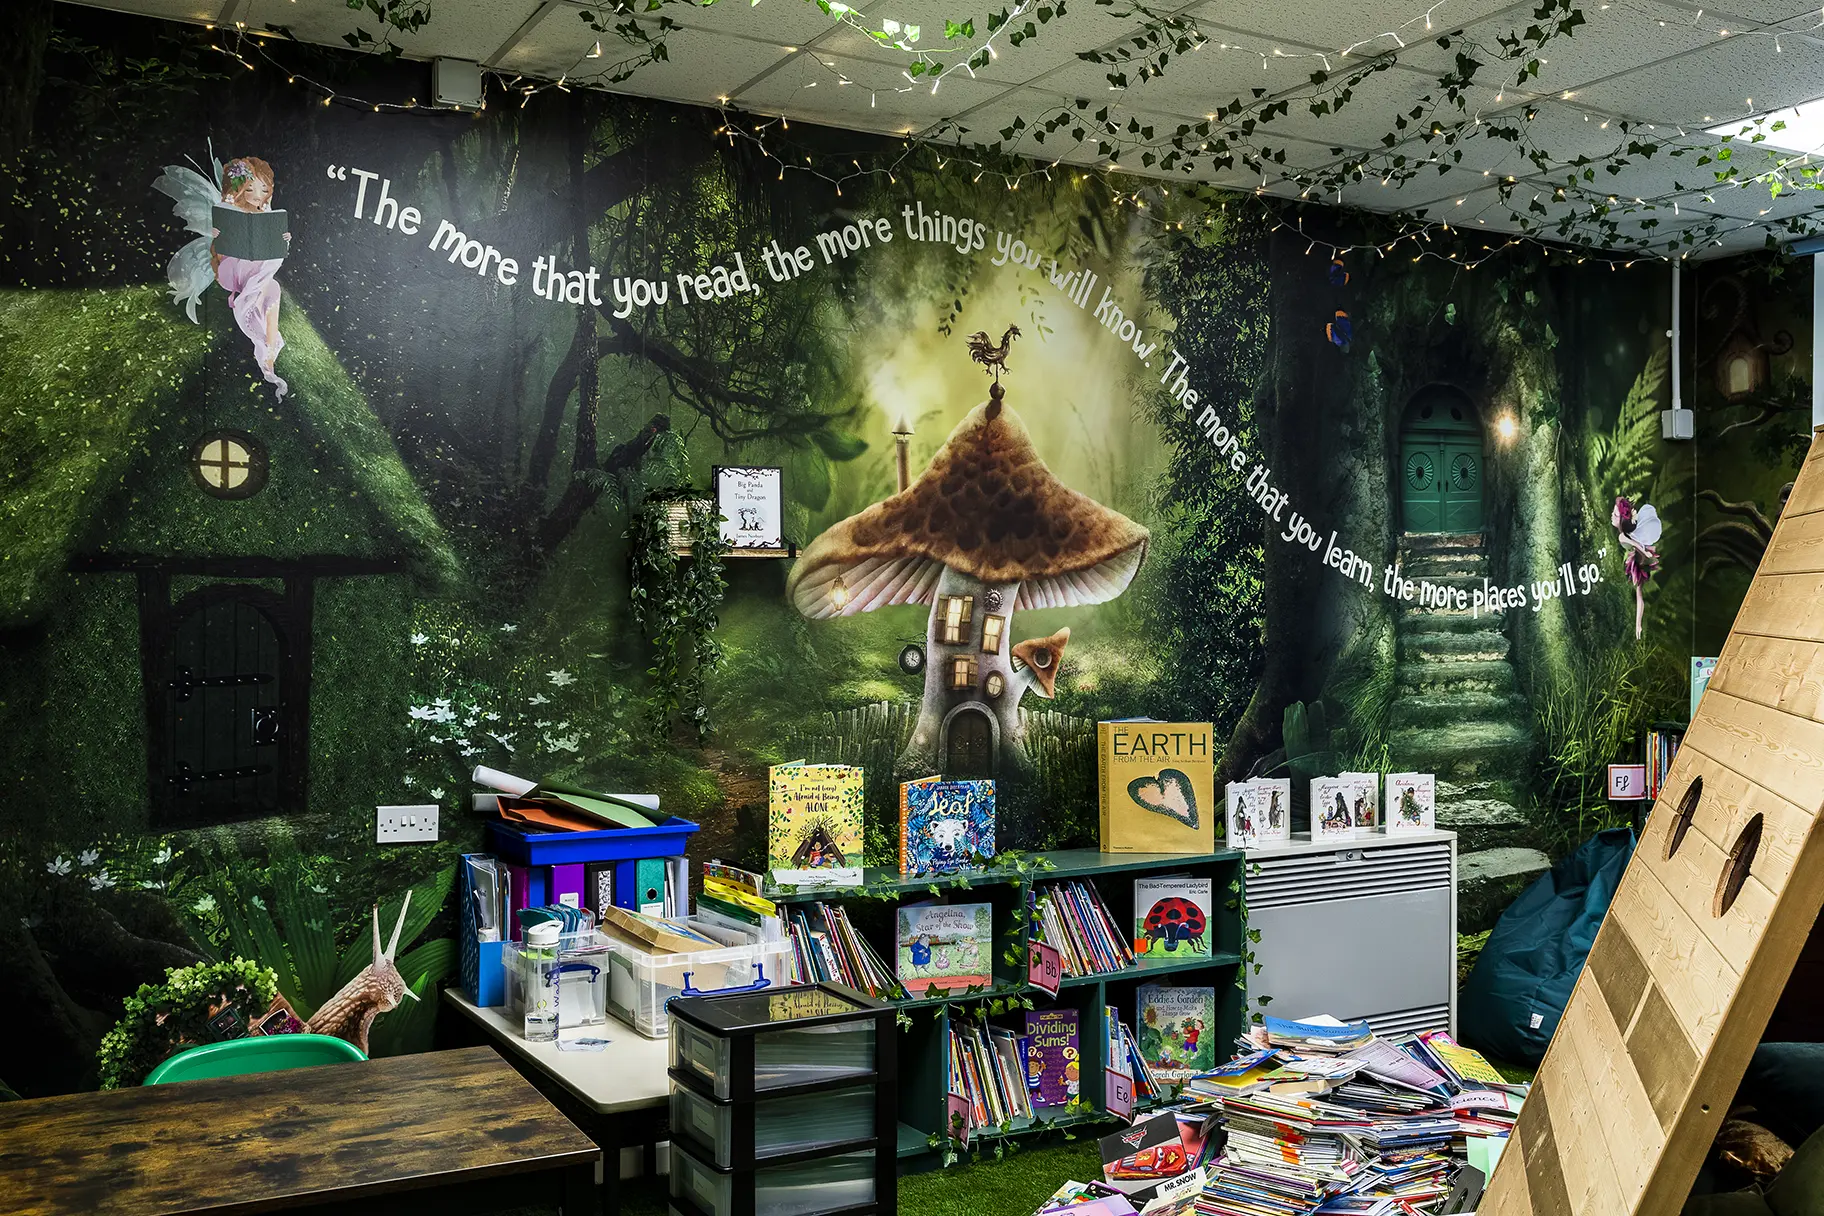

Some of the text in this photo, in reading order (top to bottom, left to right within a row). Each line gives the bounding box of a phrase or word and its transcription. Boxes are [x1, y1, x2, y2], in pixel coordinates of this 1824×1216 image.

[327, 164, 1157, 369] “The more that you read, the more things you will know.
[737, 481, 747, 489] Big
[1159, 349, 1200, 411] The
[1195, 403, 1247, 471] more
[1245, 464, 1290, 523] that
[1280, 511, 1323, 553] you
[1323, 530, 1376, 594] learn,
[1383, 563, 1415, 600] the
[1419, 579, 1468, 611] more
[1472, 577, 1527, 620] places
[1531, 566, 1577, 613] you'll
[734, 493, 766, 501] Tiny Dragon
[1113, 733, 1207, 756] EARTH
[822, 792, 840, 801] Being
[929, 790, 974, 816] Leaf
[805, 802, 829, 812] ALONE
[1186, 882, 1209, 890] Ladybird
[925, 909, 966, 923] Angelina,
[915, 923, 934, 933] Star
[953, 920, 974, 930] Show
[1045, 960, 1058, 979] Bb
[1148, 994, 1204, 1004] Eddie's Garden
[1027, 1022, 1077, 1036] Dividing
[1034, 1035, 1070, 1048] Sums!
[1151, 1070, 1199, 1079] Sarah Garland
[1116, 1086, 1130, 1104] Ee
